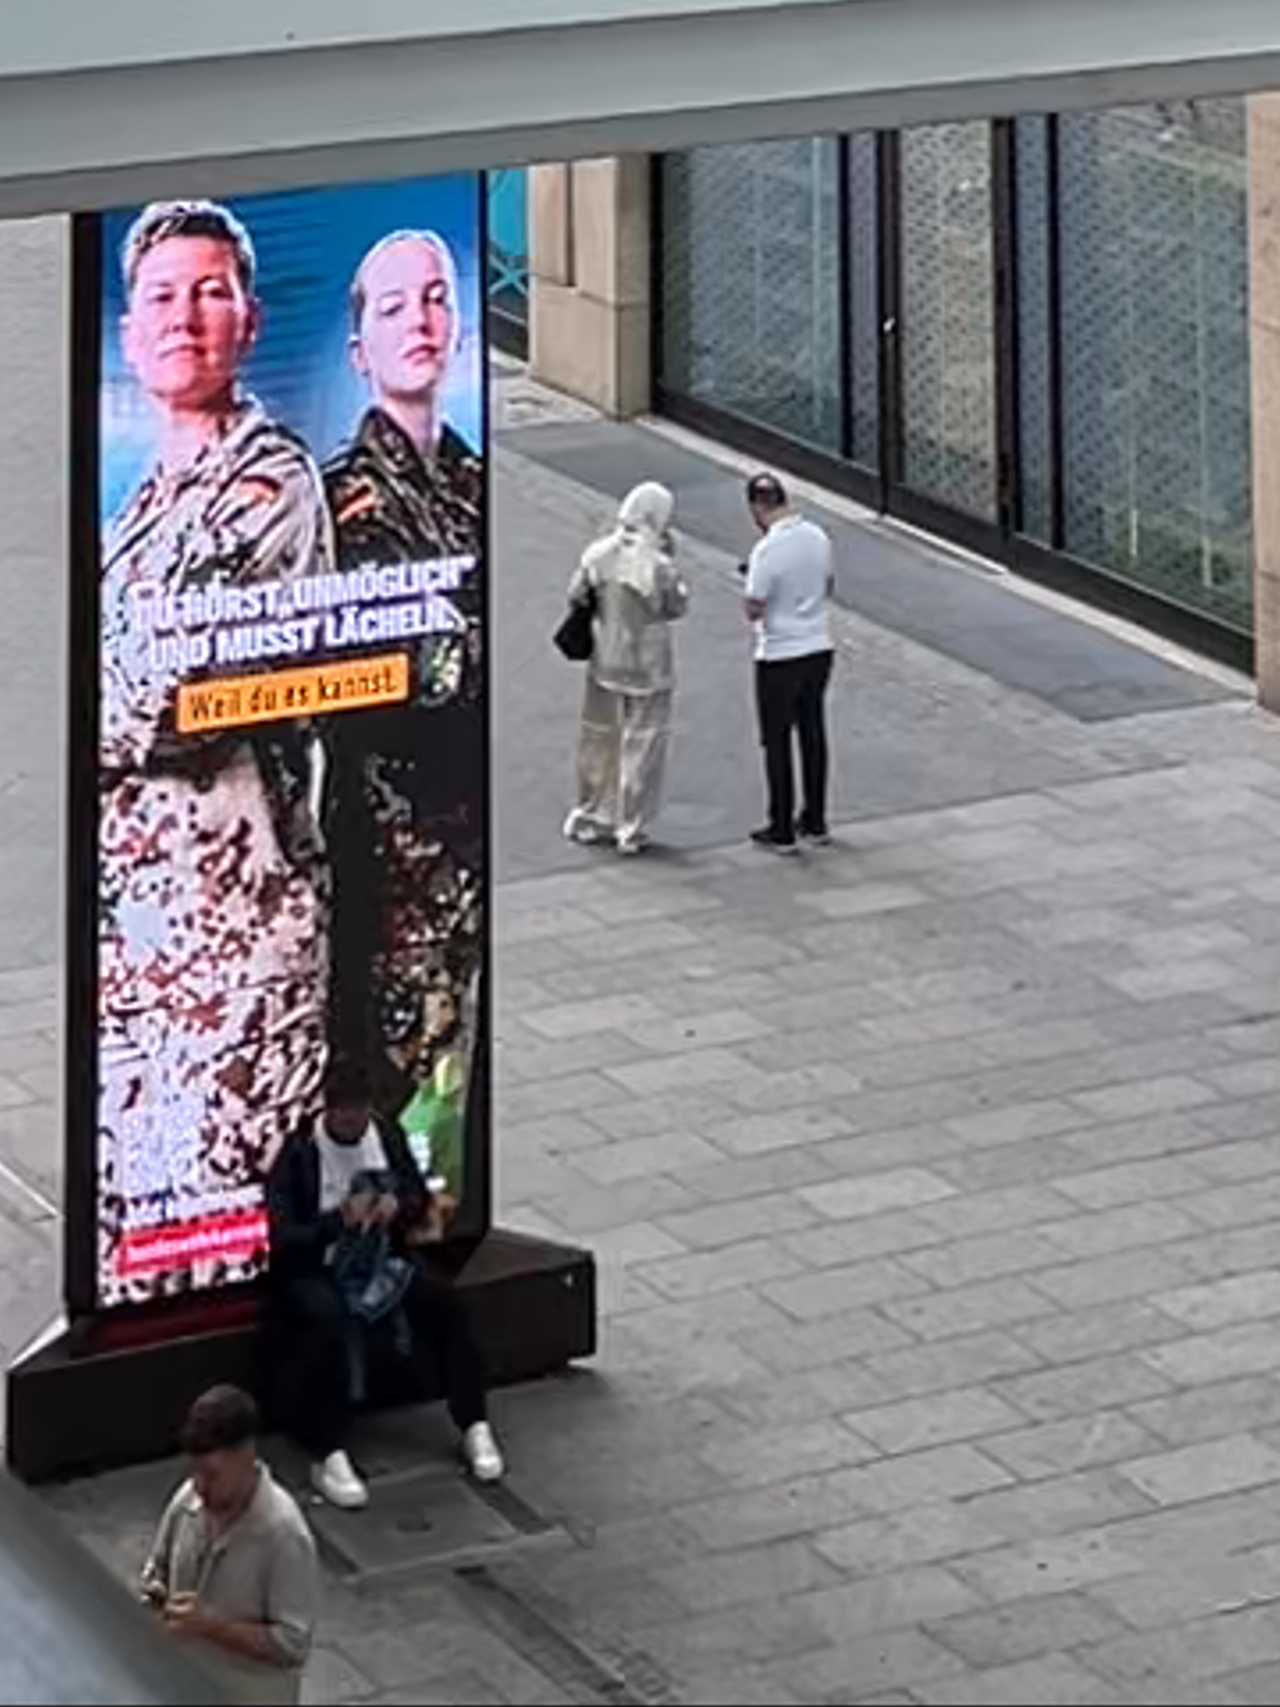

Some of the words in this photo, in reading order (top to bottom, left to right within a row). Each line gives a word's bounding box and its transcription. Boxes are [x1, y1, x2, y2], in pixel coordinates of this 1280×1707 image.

[150, 633, 210, 674] UND
[216, 616, 320, 663] MUSST
[190, 688, 242, 720] Weil
[248, 685, 278, 714] du
[284, 683, 308, 709] es
